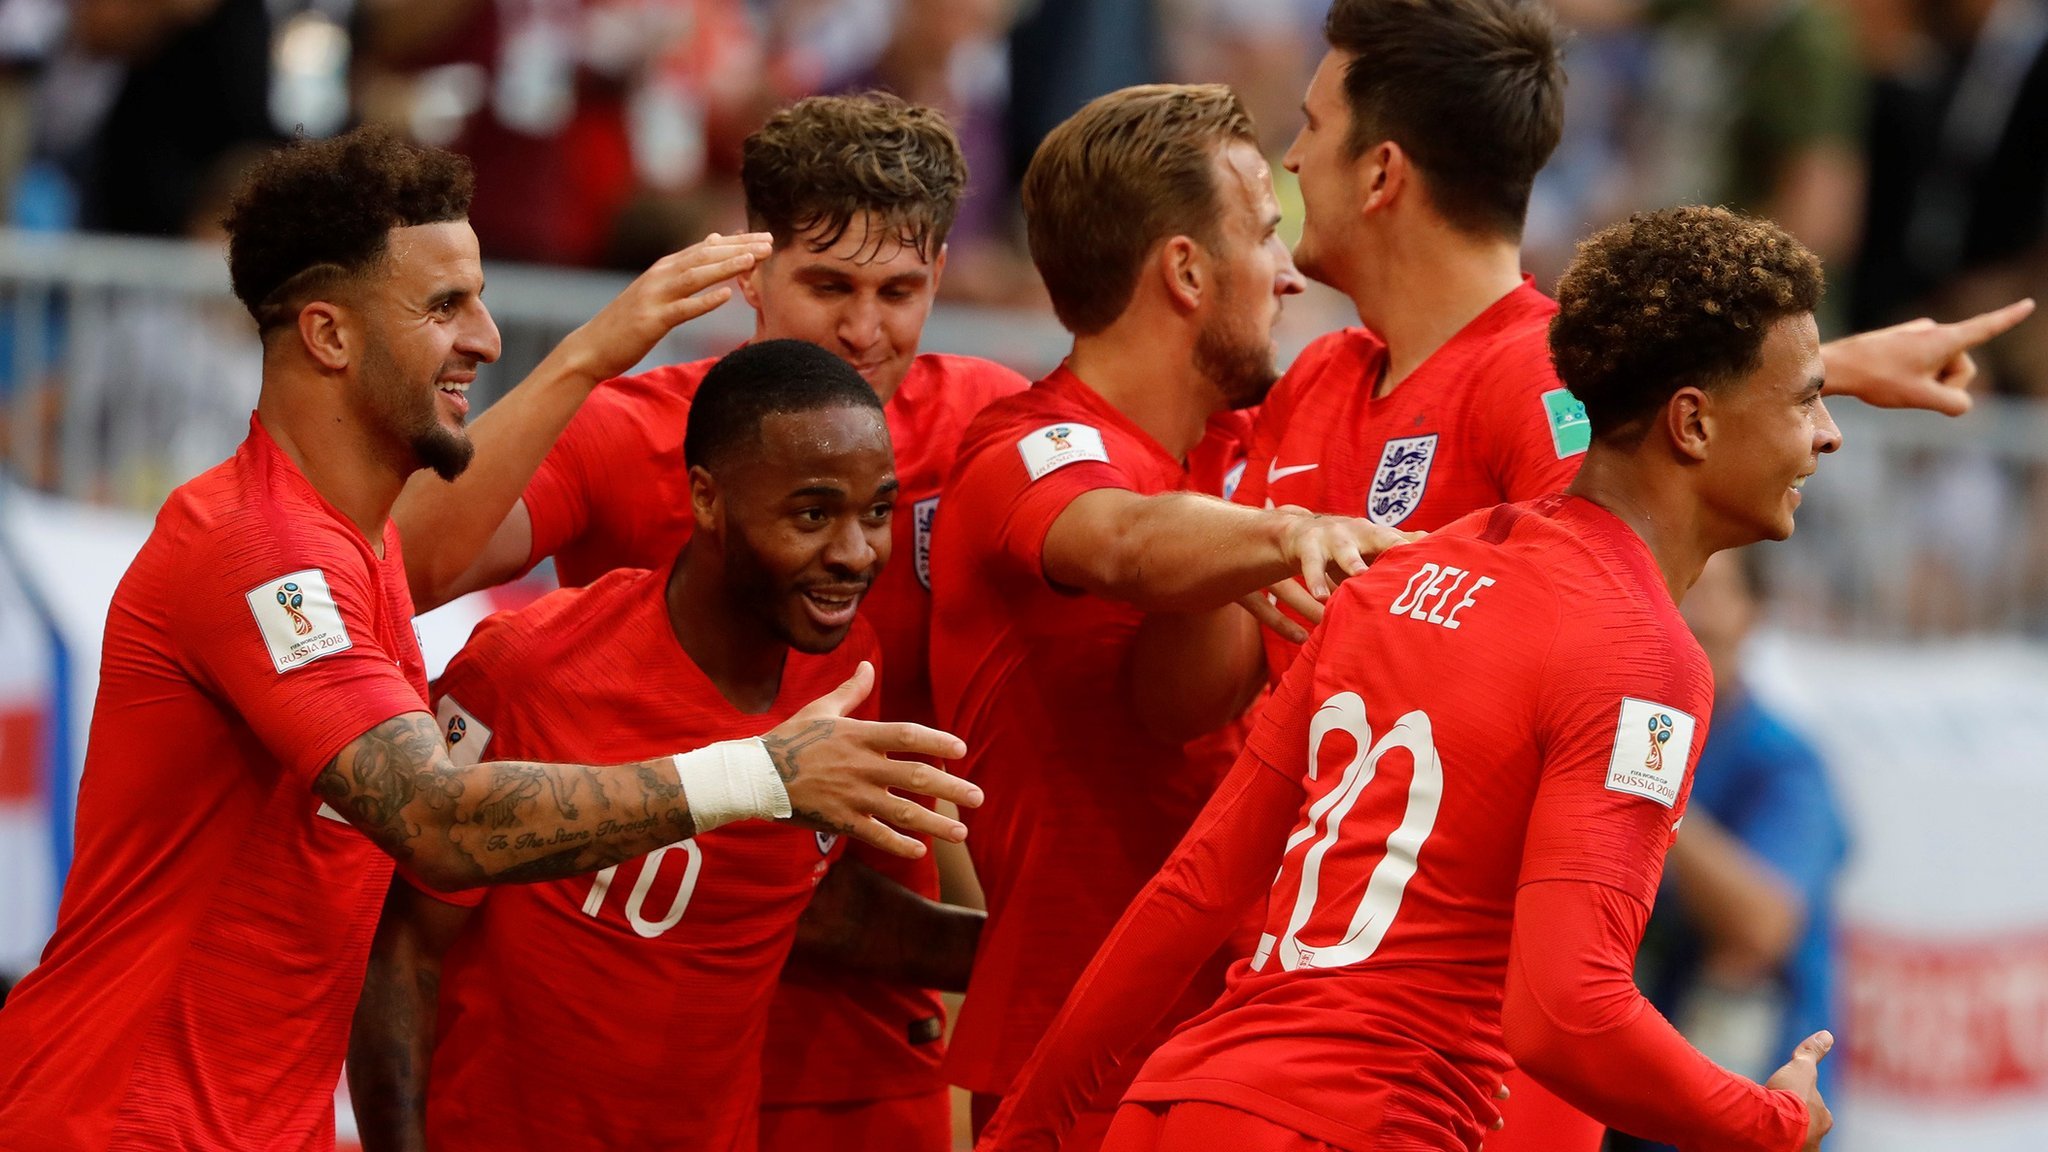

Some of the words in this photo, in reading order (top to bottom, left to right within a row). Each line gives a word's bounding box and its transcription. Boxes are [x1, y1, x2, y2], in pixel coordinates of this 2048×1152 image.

[1389, 562, 1496, 630] DELE
[279, 643, 320, 665] RUSSIA
[319, 635, 344, 649] 2018
[1613, 773, 1655, 791] RUSSIA
[1656, 785, 1675, 799] 2018
[487, 834, 509, 851] To
[514, 831, 545, 849] The
[595, 813, 659, 838] Through
[1251, 691, 1443, 972] 20
